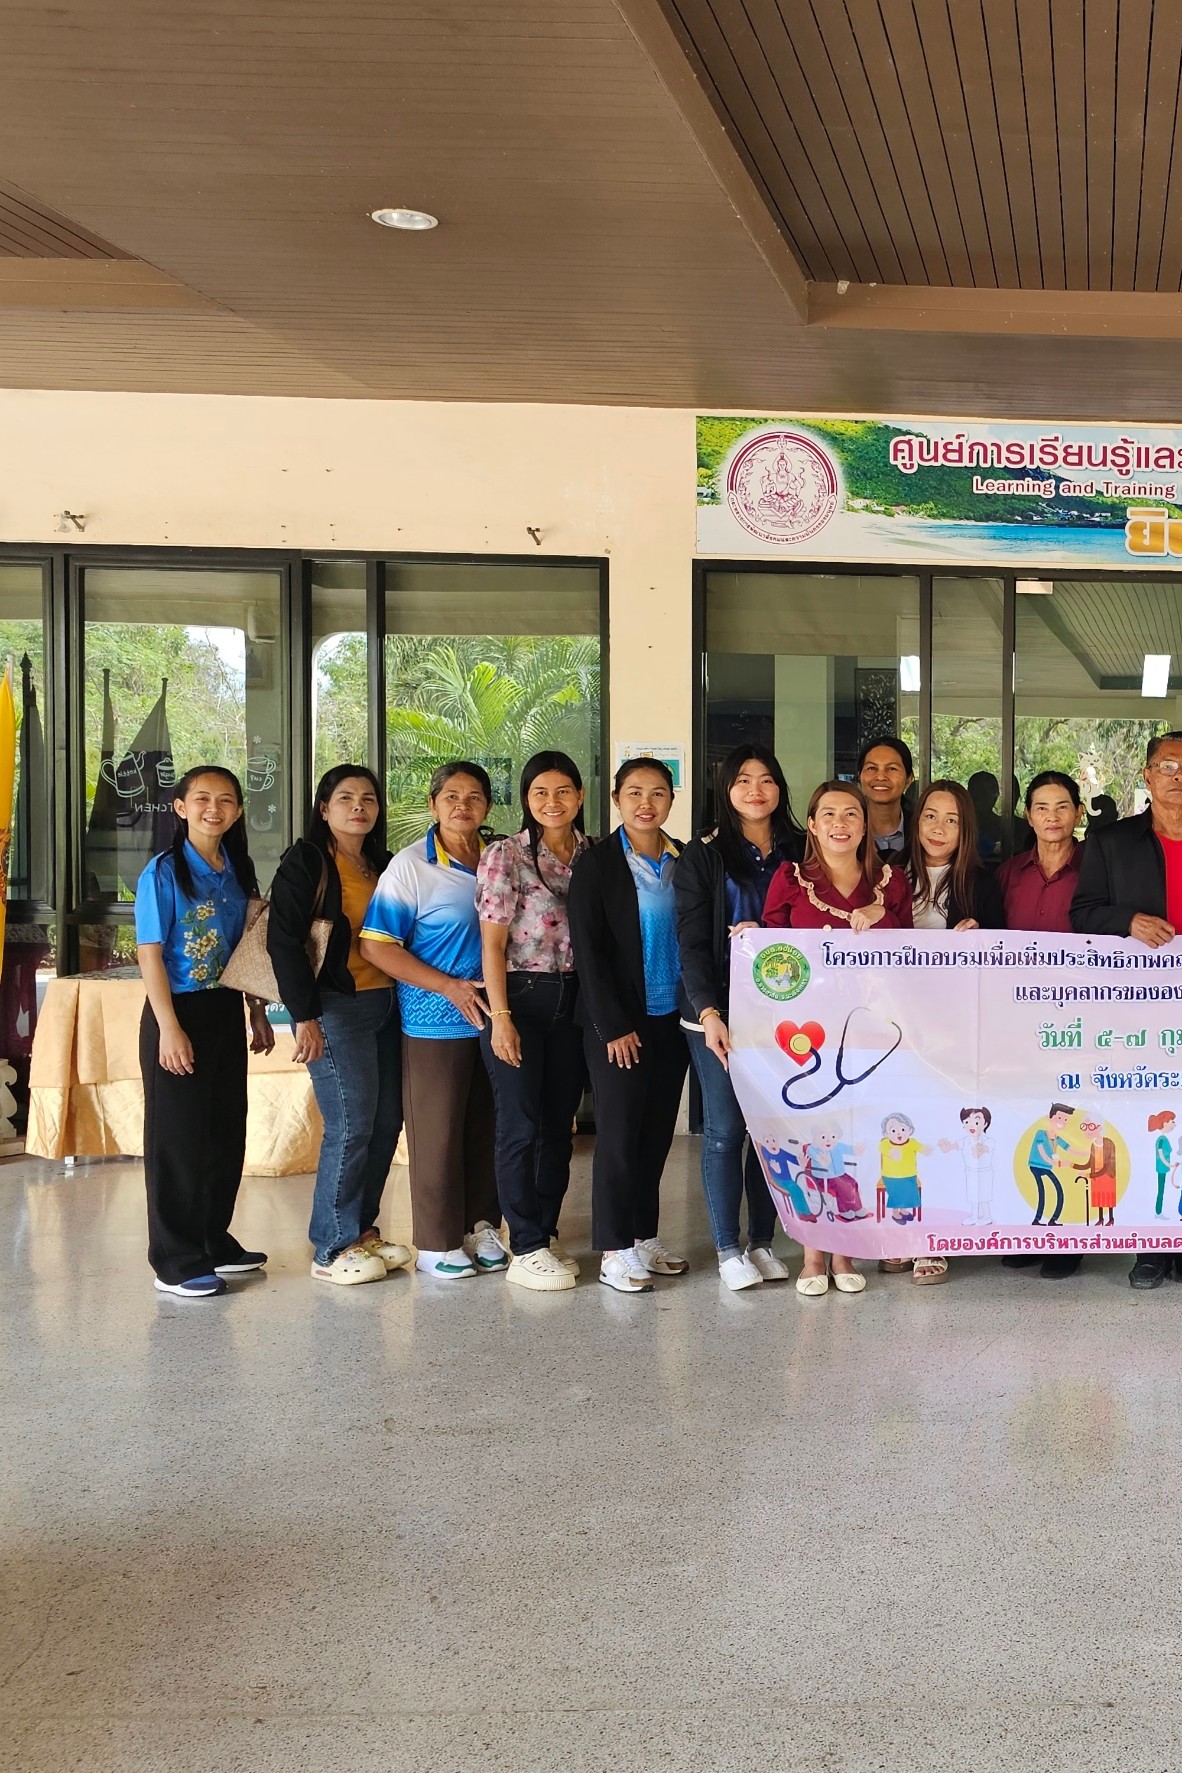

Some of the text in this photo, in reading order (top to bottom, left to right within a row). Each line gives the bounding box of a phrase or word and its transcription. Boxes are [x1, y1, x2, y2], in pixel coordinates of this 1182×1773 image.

[975, 478, 1054, 496] Learning
[1064, 481, 1096, 496] and
[1102, 481, 1176, 499] Training
[1039, 1017, 1082, 1048] วันที่
[1097, 1029, 1147, 1047] ๕-๗
[1060, 1073, 1081, 1089] ณ
